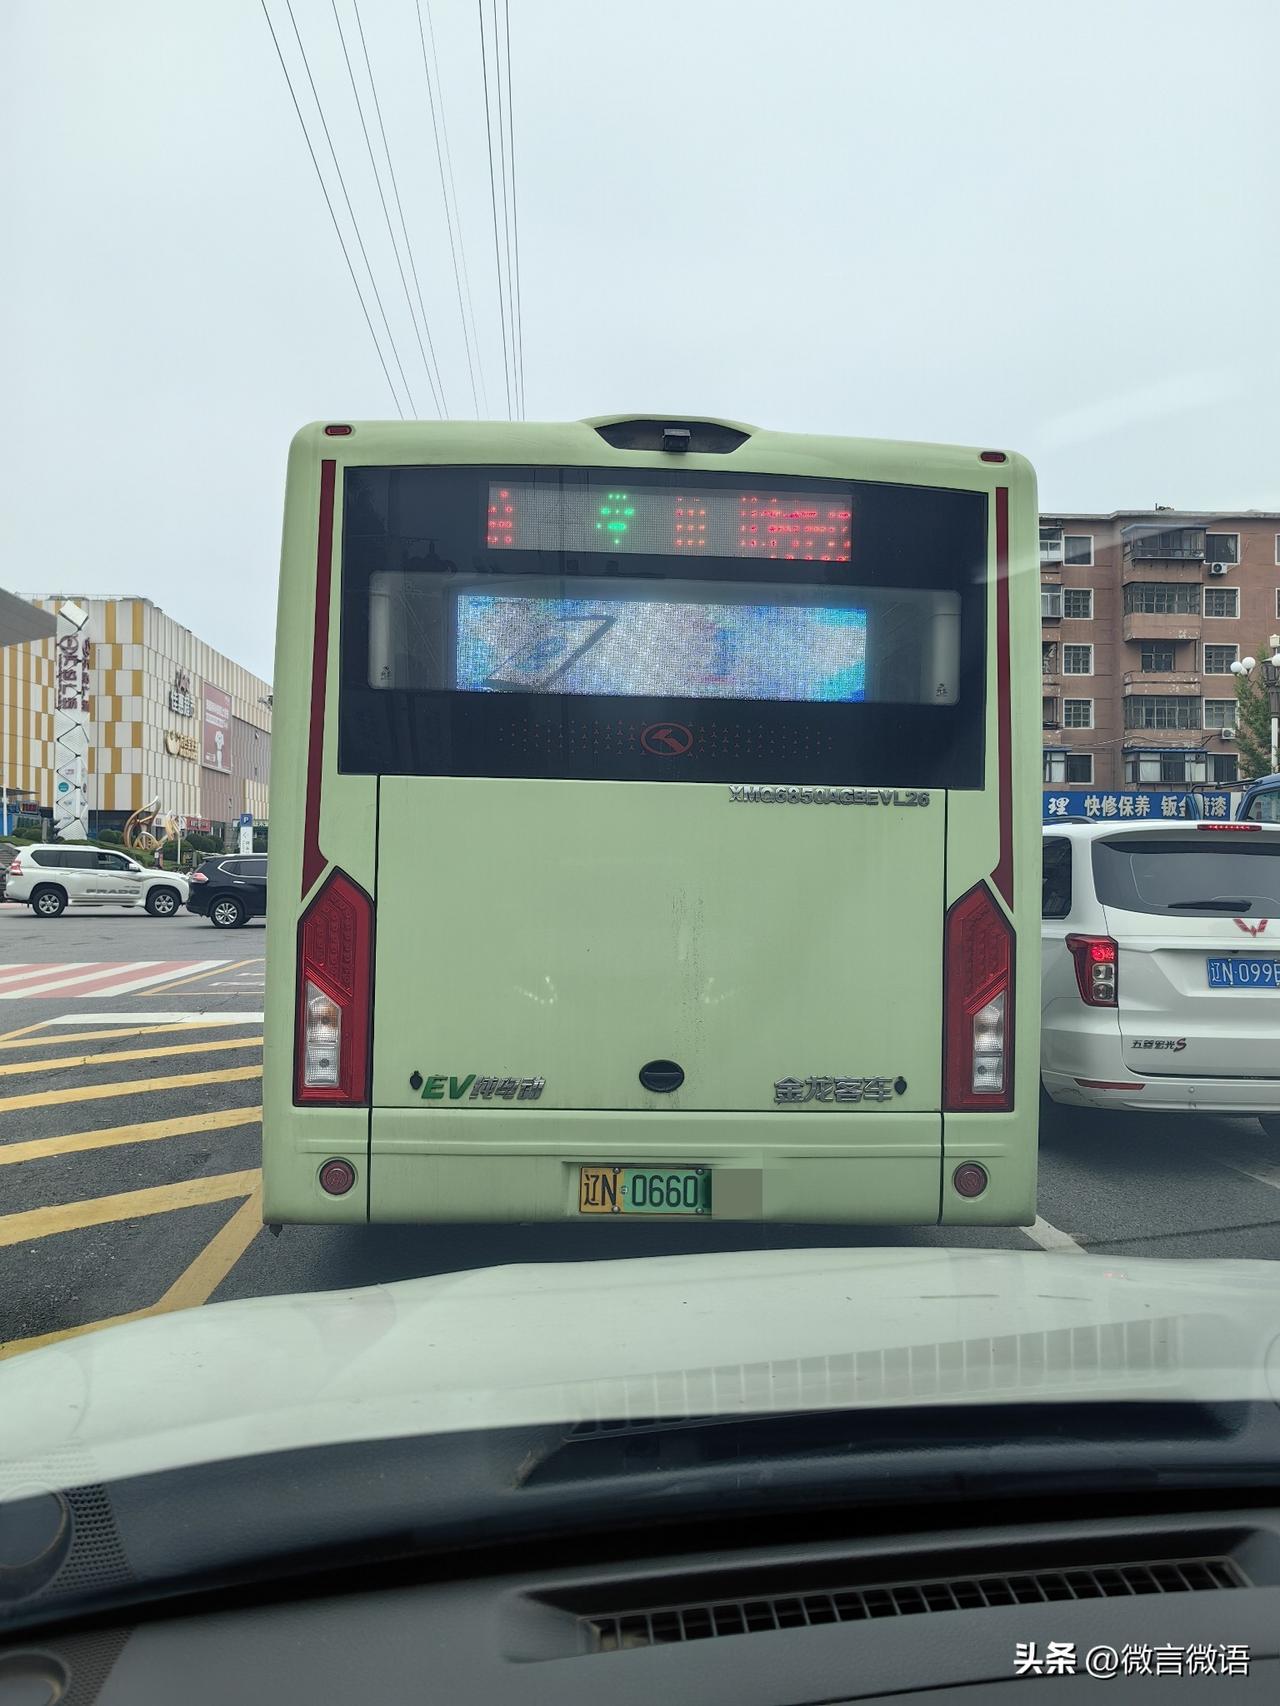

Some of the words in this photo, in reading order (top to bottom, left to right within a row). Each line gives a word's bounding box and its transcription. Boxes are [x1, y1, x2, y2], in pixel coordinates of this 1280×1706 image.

[1085, 795, 1150, 817] 快修保养
[774, 1076, 893, 1104] 金龙客车
